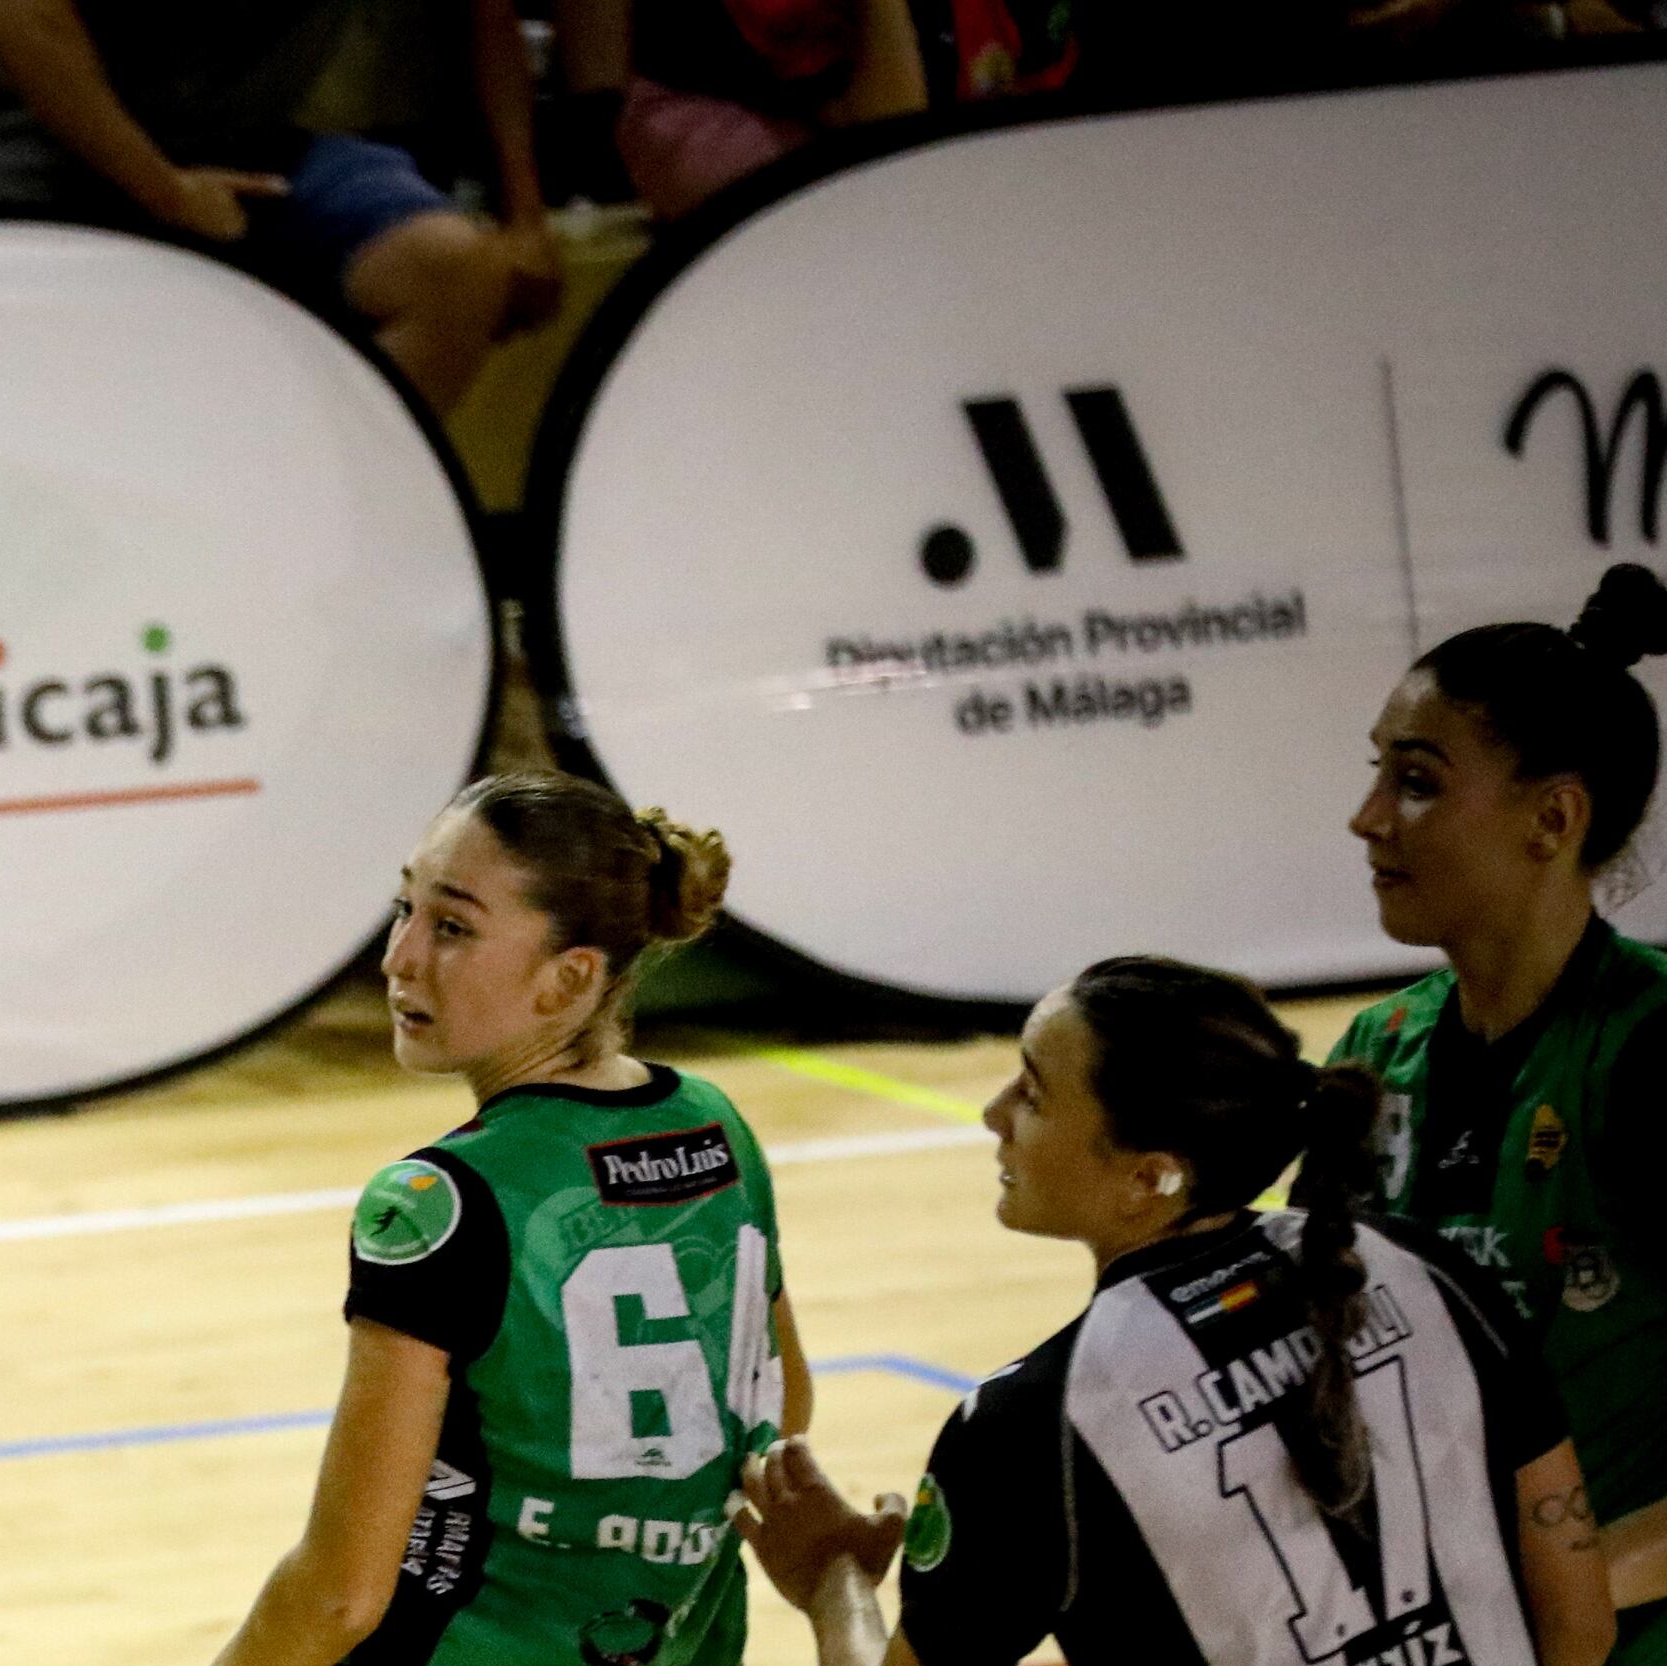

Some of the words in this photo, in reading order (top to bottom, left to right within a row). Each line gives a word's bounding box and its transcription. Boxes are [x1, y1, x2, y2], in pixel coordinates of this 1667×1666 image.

[1083, 587, 1308, 656] Provincial
[954, 690, 1015, 737] de
[1024, 674, 1194, 727] Málaga
